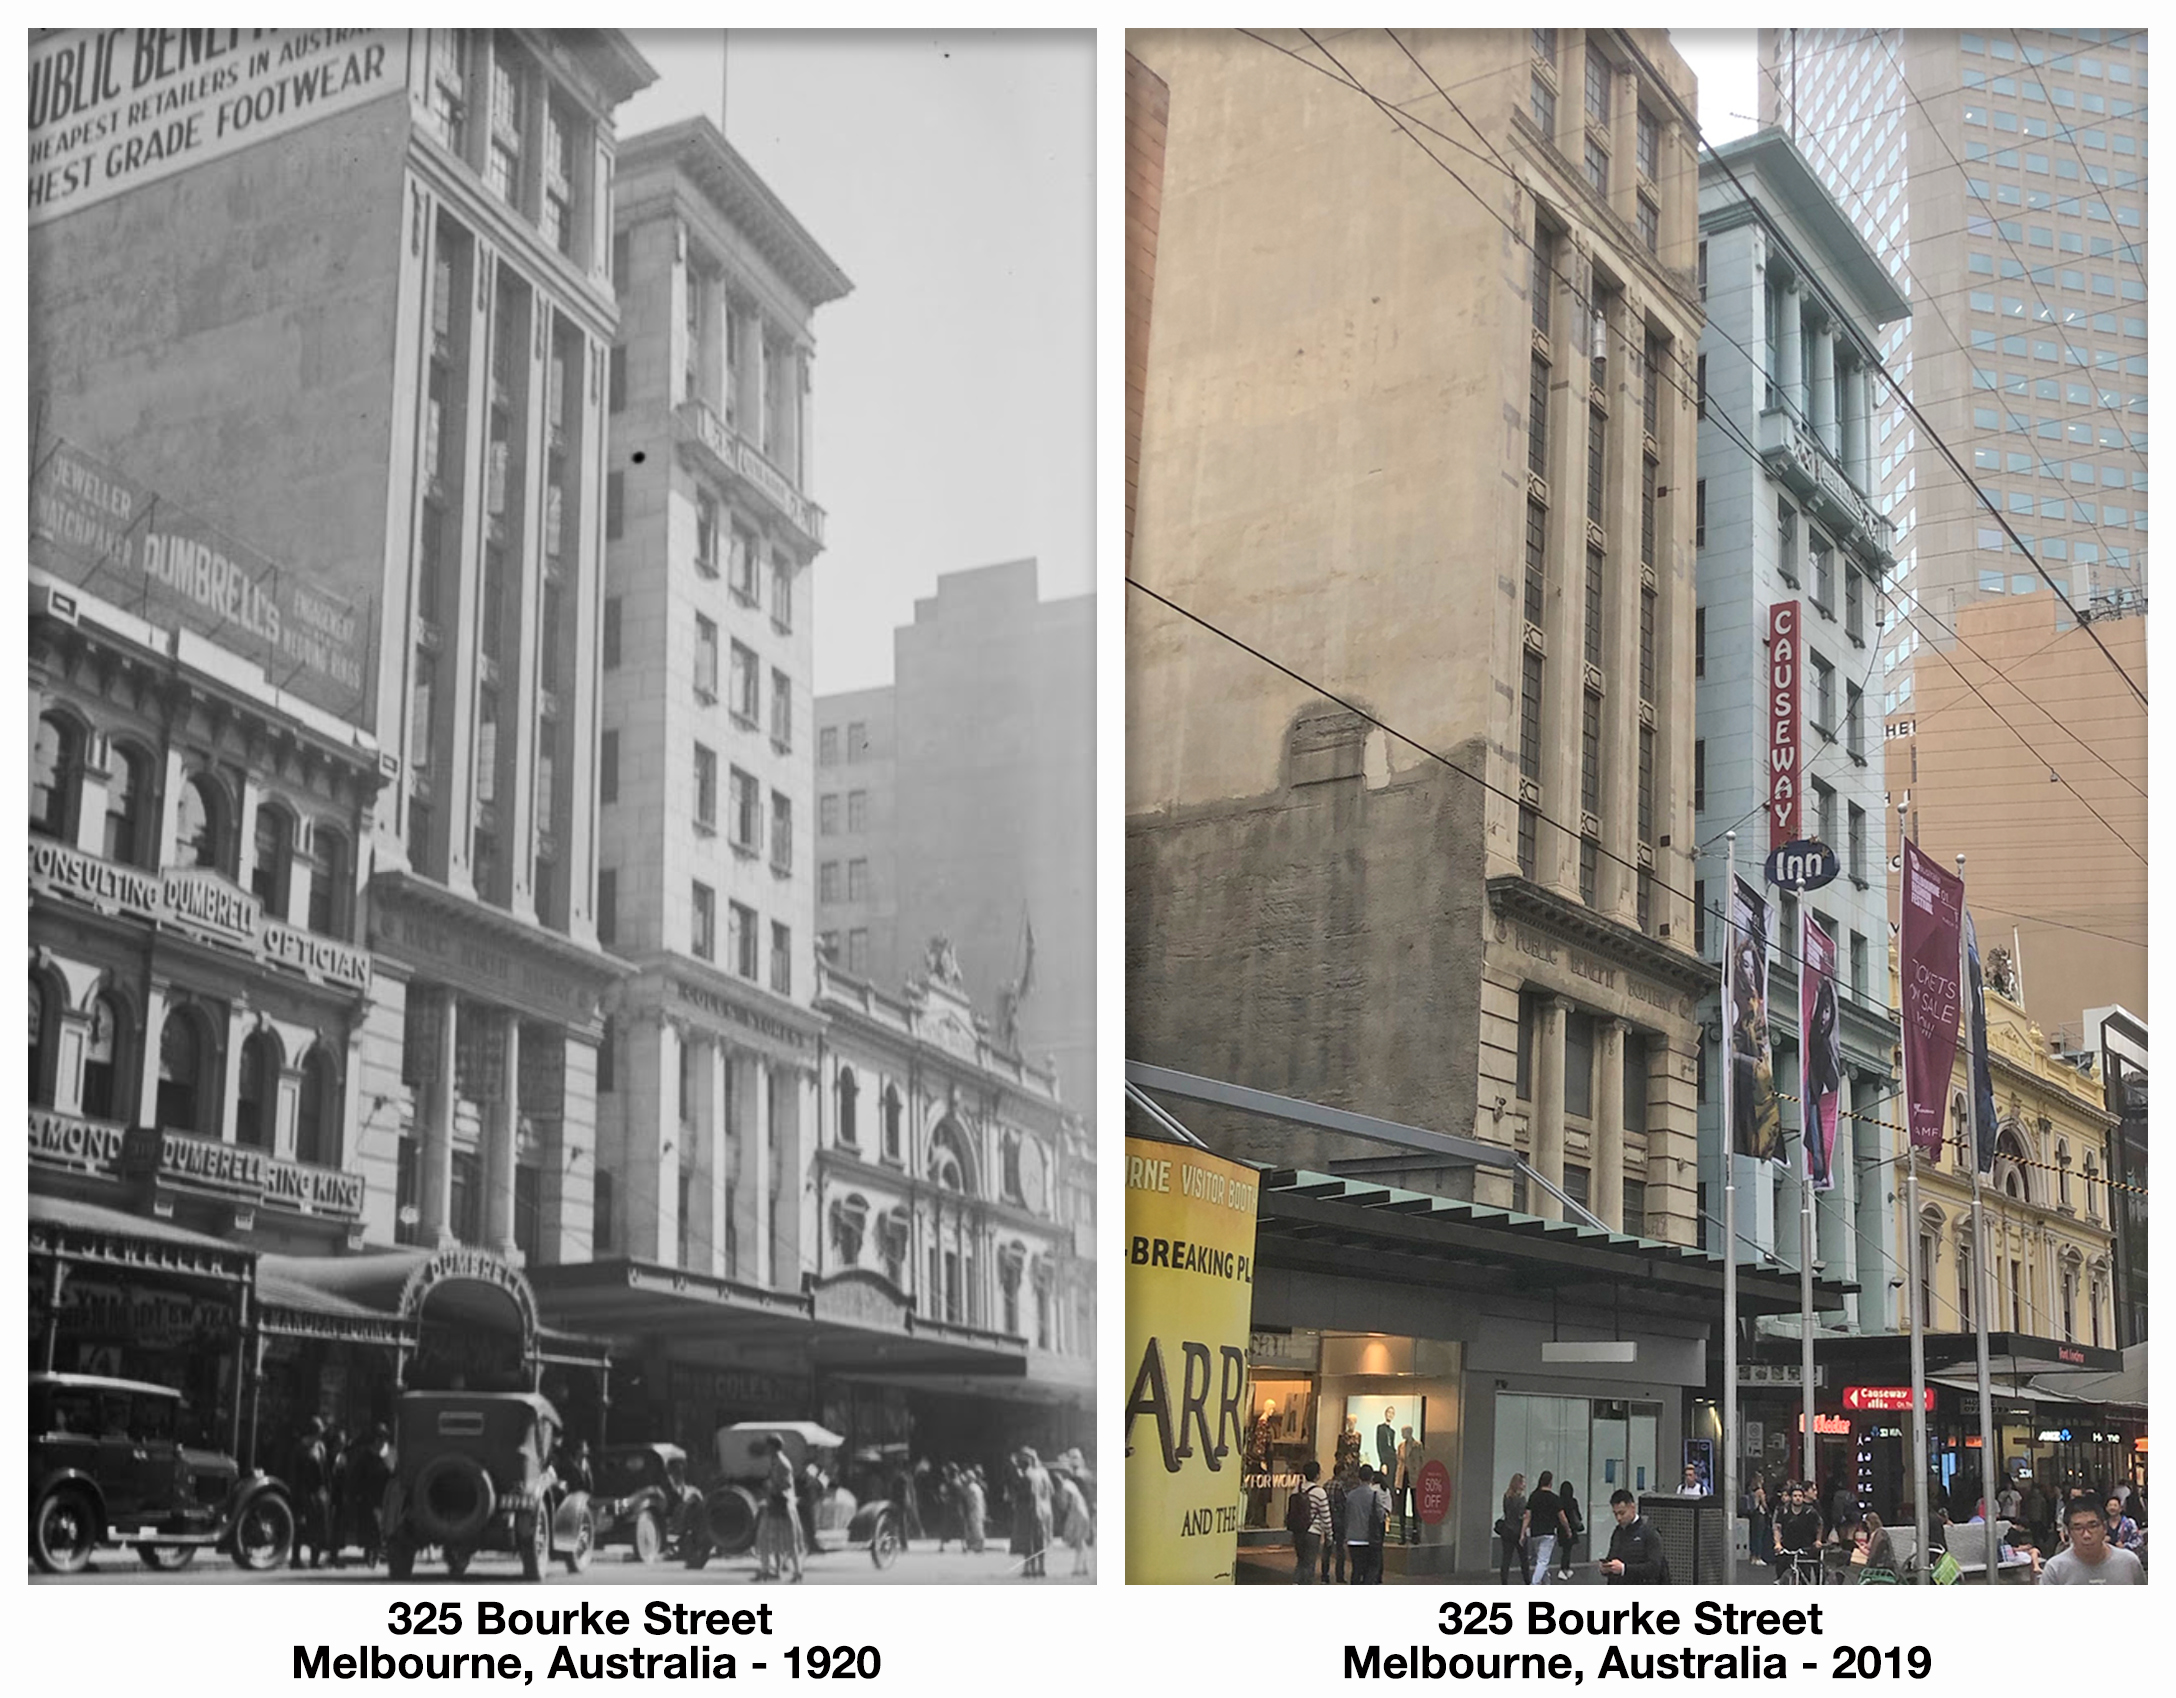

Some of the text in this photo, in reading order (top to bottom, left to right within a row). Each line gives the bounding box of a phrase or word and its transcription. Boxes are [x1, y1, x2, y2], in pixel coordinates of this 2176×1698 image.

[127, 61, 239, 128] RETAILERS
[249, 49, 270, 79] IN
[28, 44, 386, 208] HEST GRADE FOOTWEAR
[51, 453, 132, 522] JEWELLER
[143, 532, 281, 645] DUMBRELL'S
[1771, 610, 1795, 828] CAUSEWAY
[1776, 850, 1823, 882] Inn
[162, 878, 257, 932] DUMBRELL
[264, 926, 367, 983] OPTICIAN
[1516, 929, 1559, 965] PUBLIC
[1921, 992, 1956, 1024] SALE
[163, 1136, 266, 1184] DUMBRELL
[312, 1173, 361, 1208] KING
[1182, 1163, 1226, 1206] VISITOR
[1237, 1254, 1254, 1285] PL
[1861, 1387, 1908, 1399] Causeway
[1251, 1474, 1271, 1489] FOR
[1425, 1478, 1442, 1492] 50%
[1424, 1494, 1441, 1508] OFF
[1181, 1508, 1213, 1538] AND
